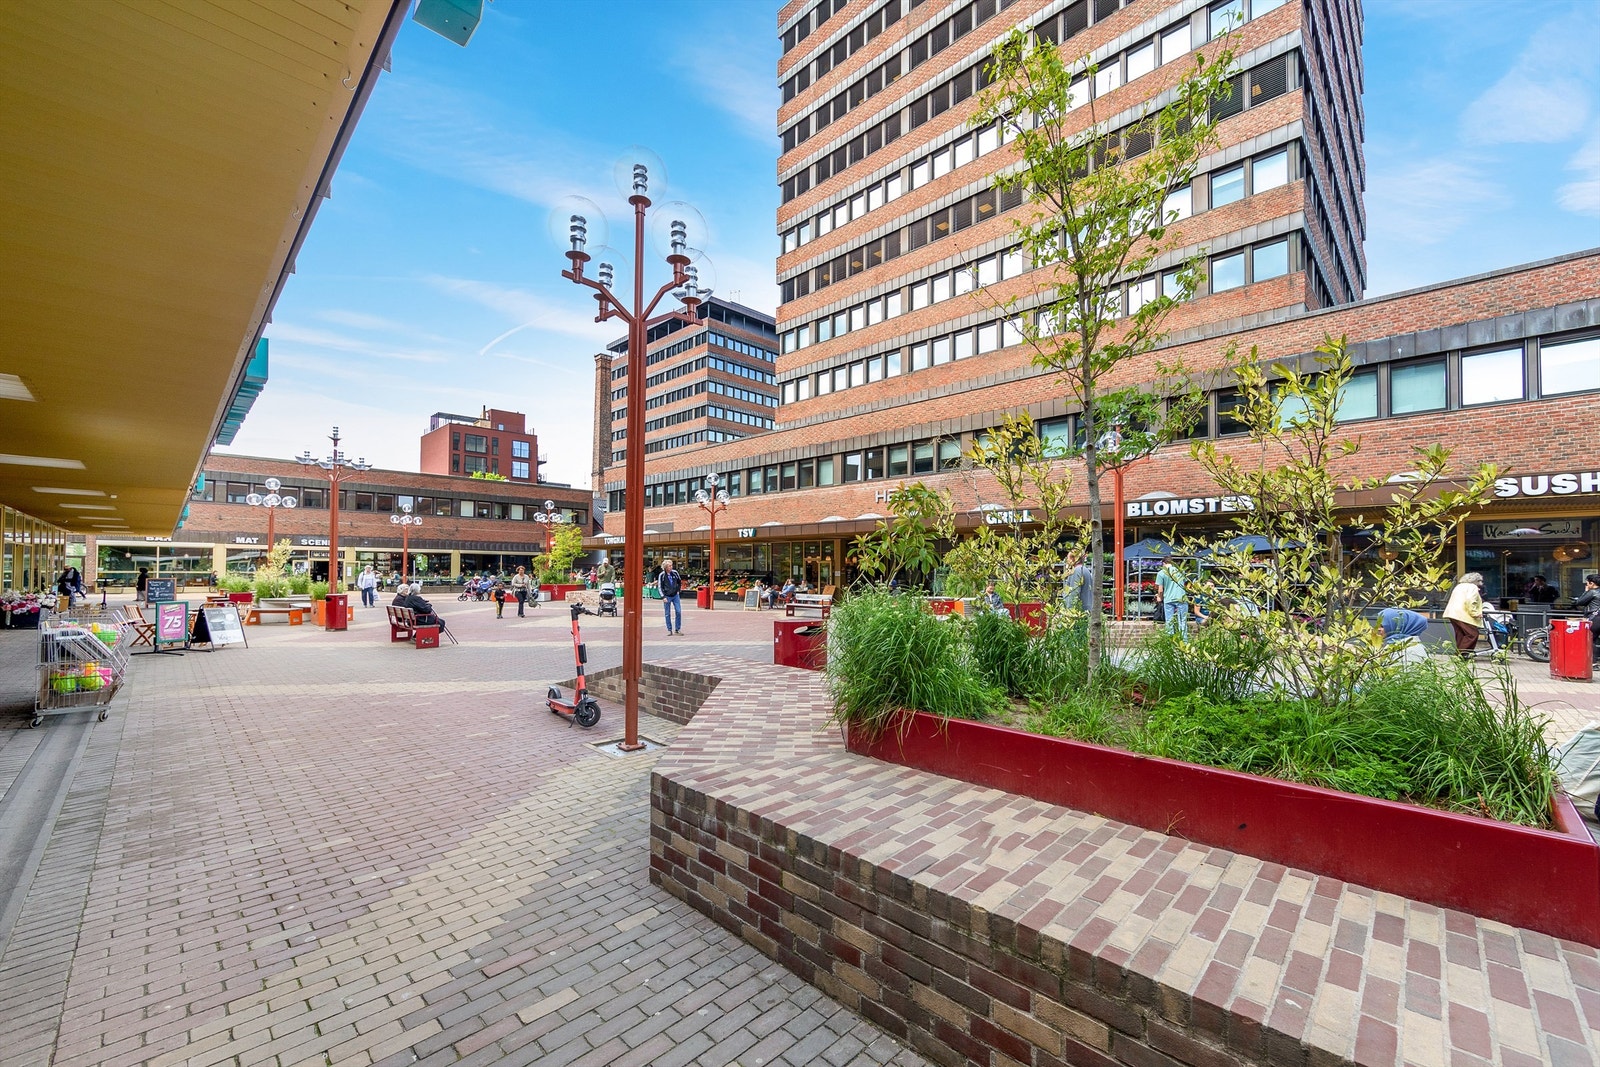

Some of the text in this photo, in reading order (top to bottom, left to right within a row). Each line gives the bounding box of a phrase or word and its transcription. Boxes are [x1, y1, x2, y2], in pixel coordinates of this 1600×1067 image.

[1494, 472, 1600, 497] SUSH
[1127, 495, 1255, 517] BLOMSTER
[738, 528, 756, 538] TSV
[164, 615, 182, 629] 75
